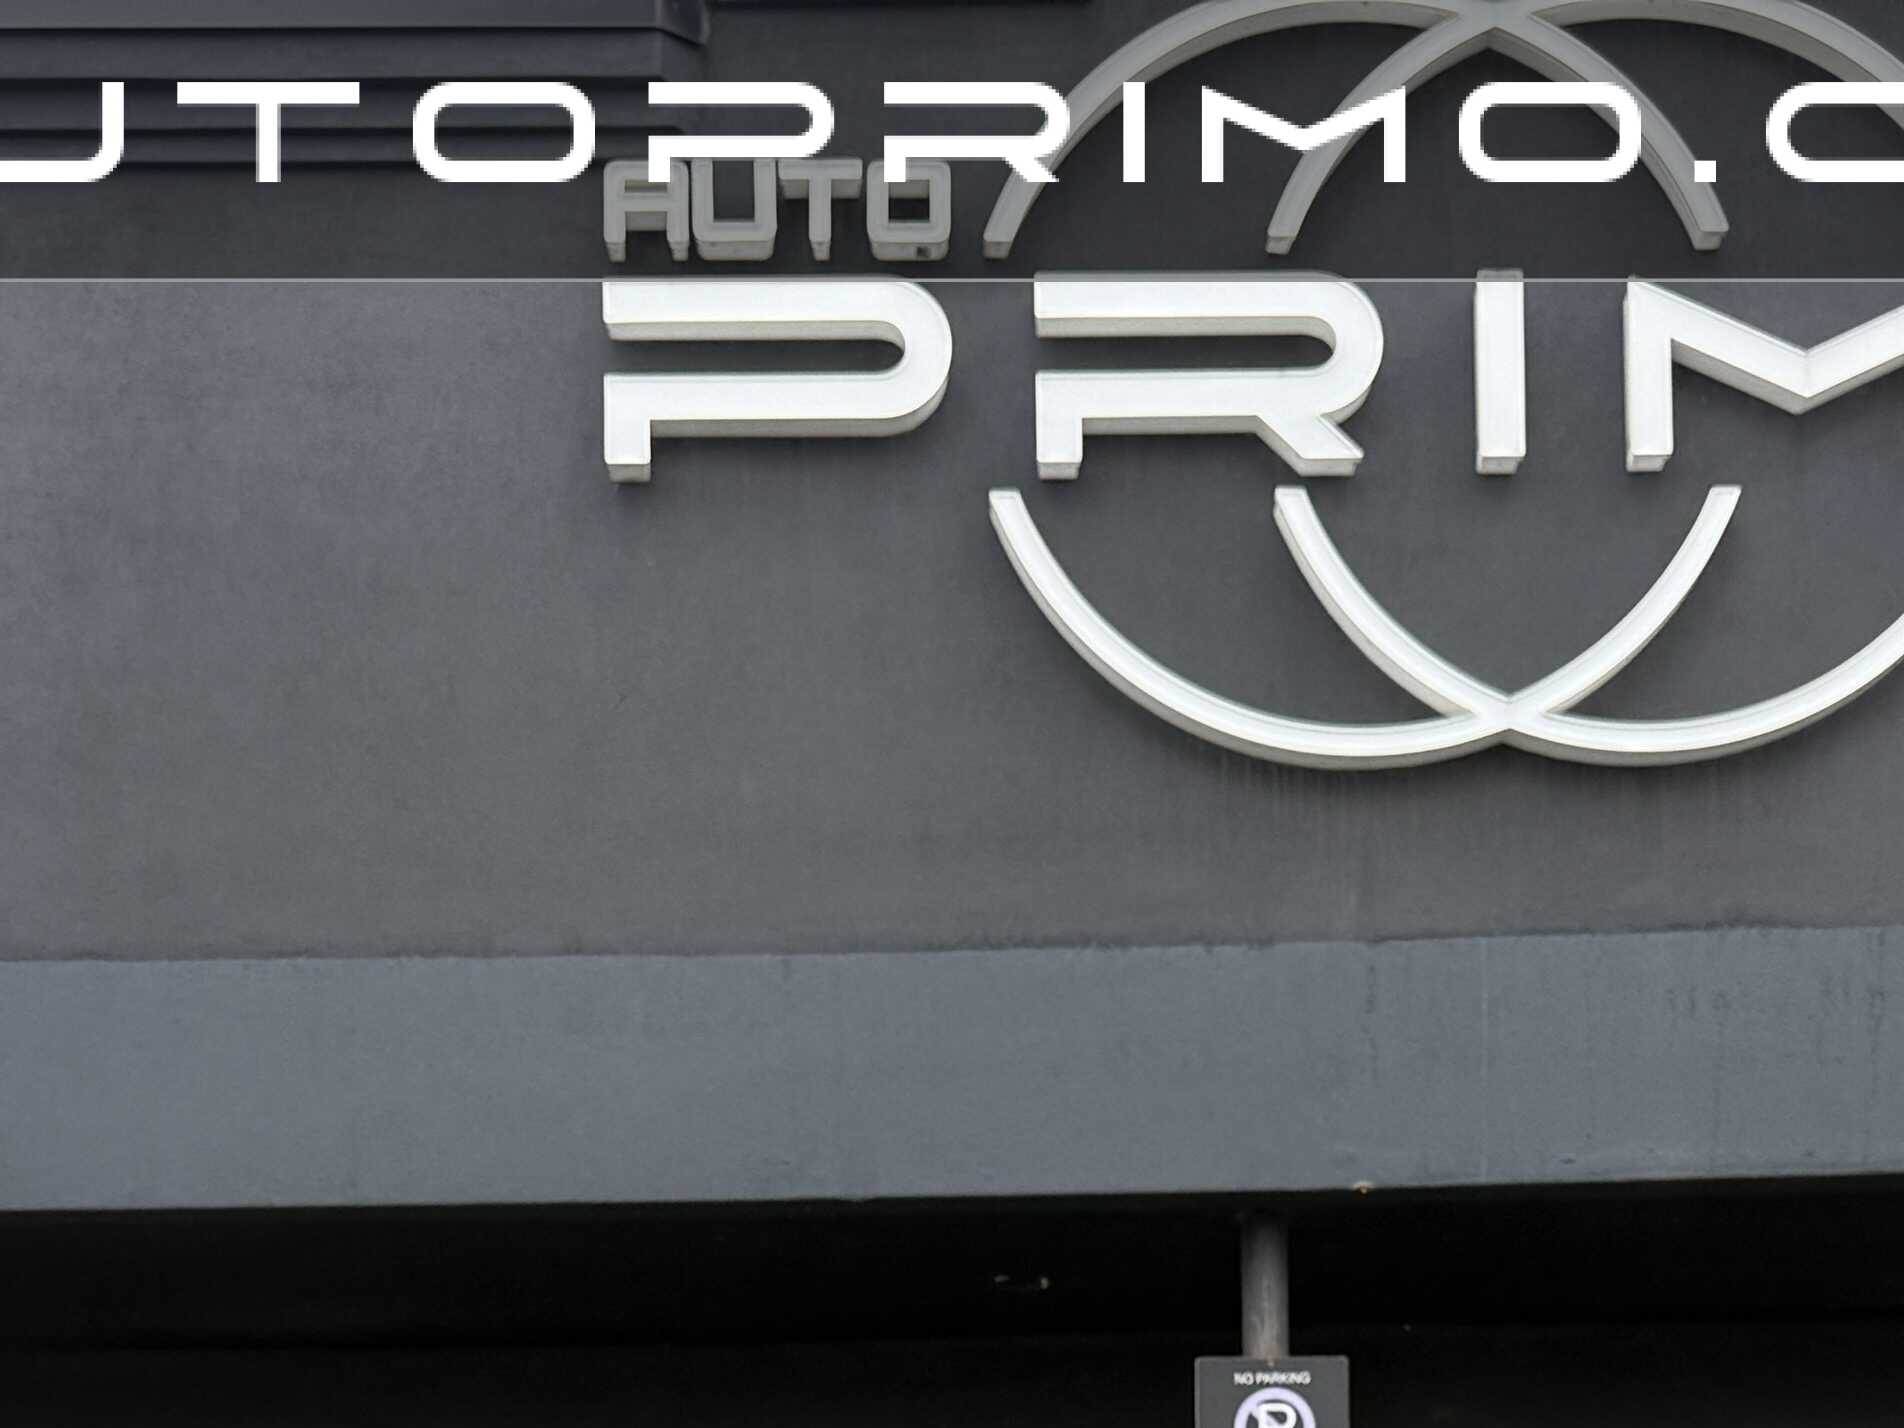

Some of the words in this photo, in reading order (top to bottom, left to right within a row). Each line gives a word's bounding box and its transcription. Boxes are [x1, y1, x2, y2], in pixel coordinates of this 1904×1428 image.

[603, 158, 951, 262] AUTO
[1233, 1371, 1254, 1386] NO
[1255, 1370, 1312, 1385] PARKING
